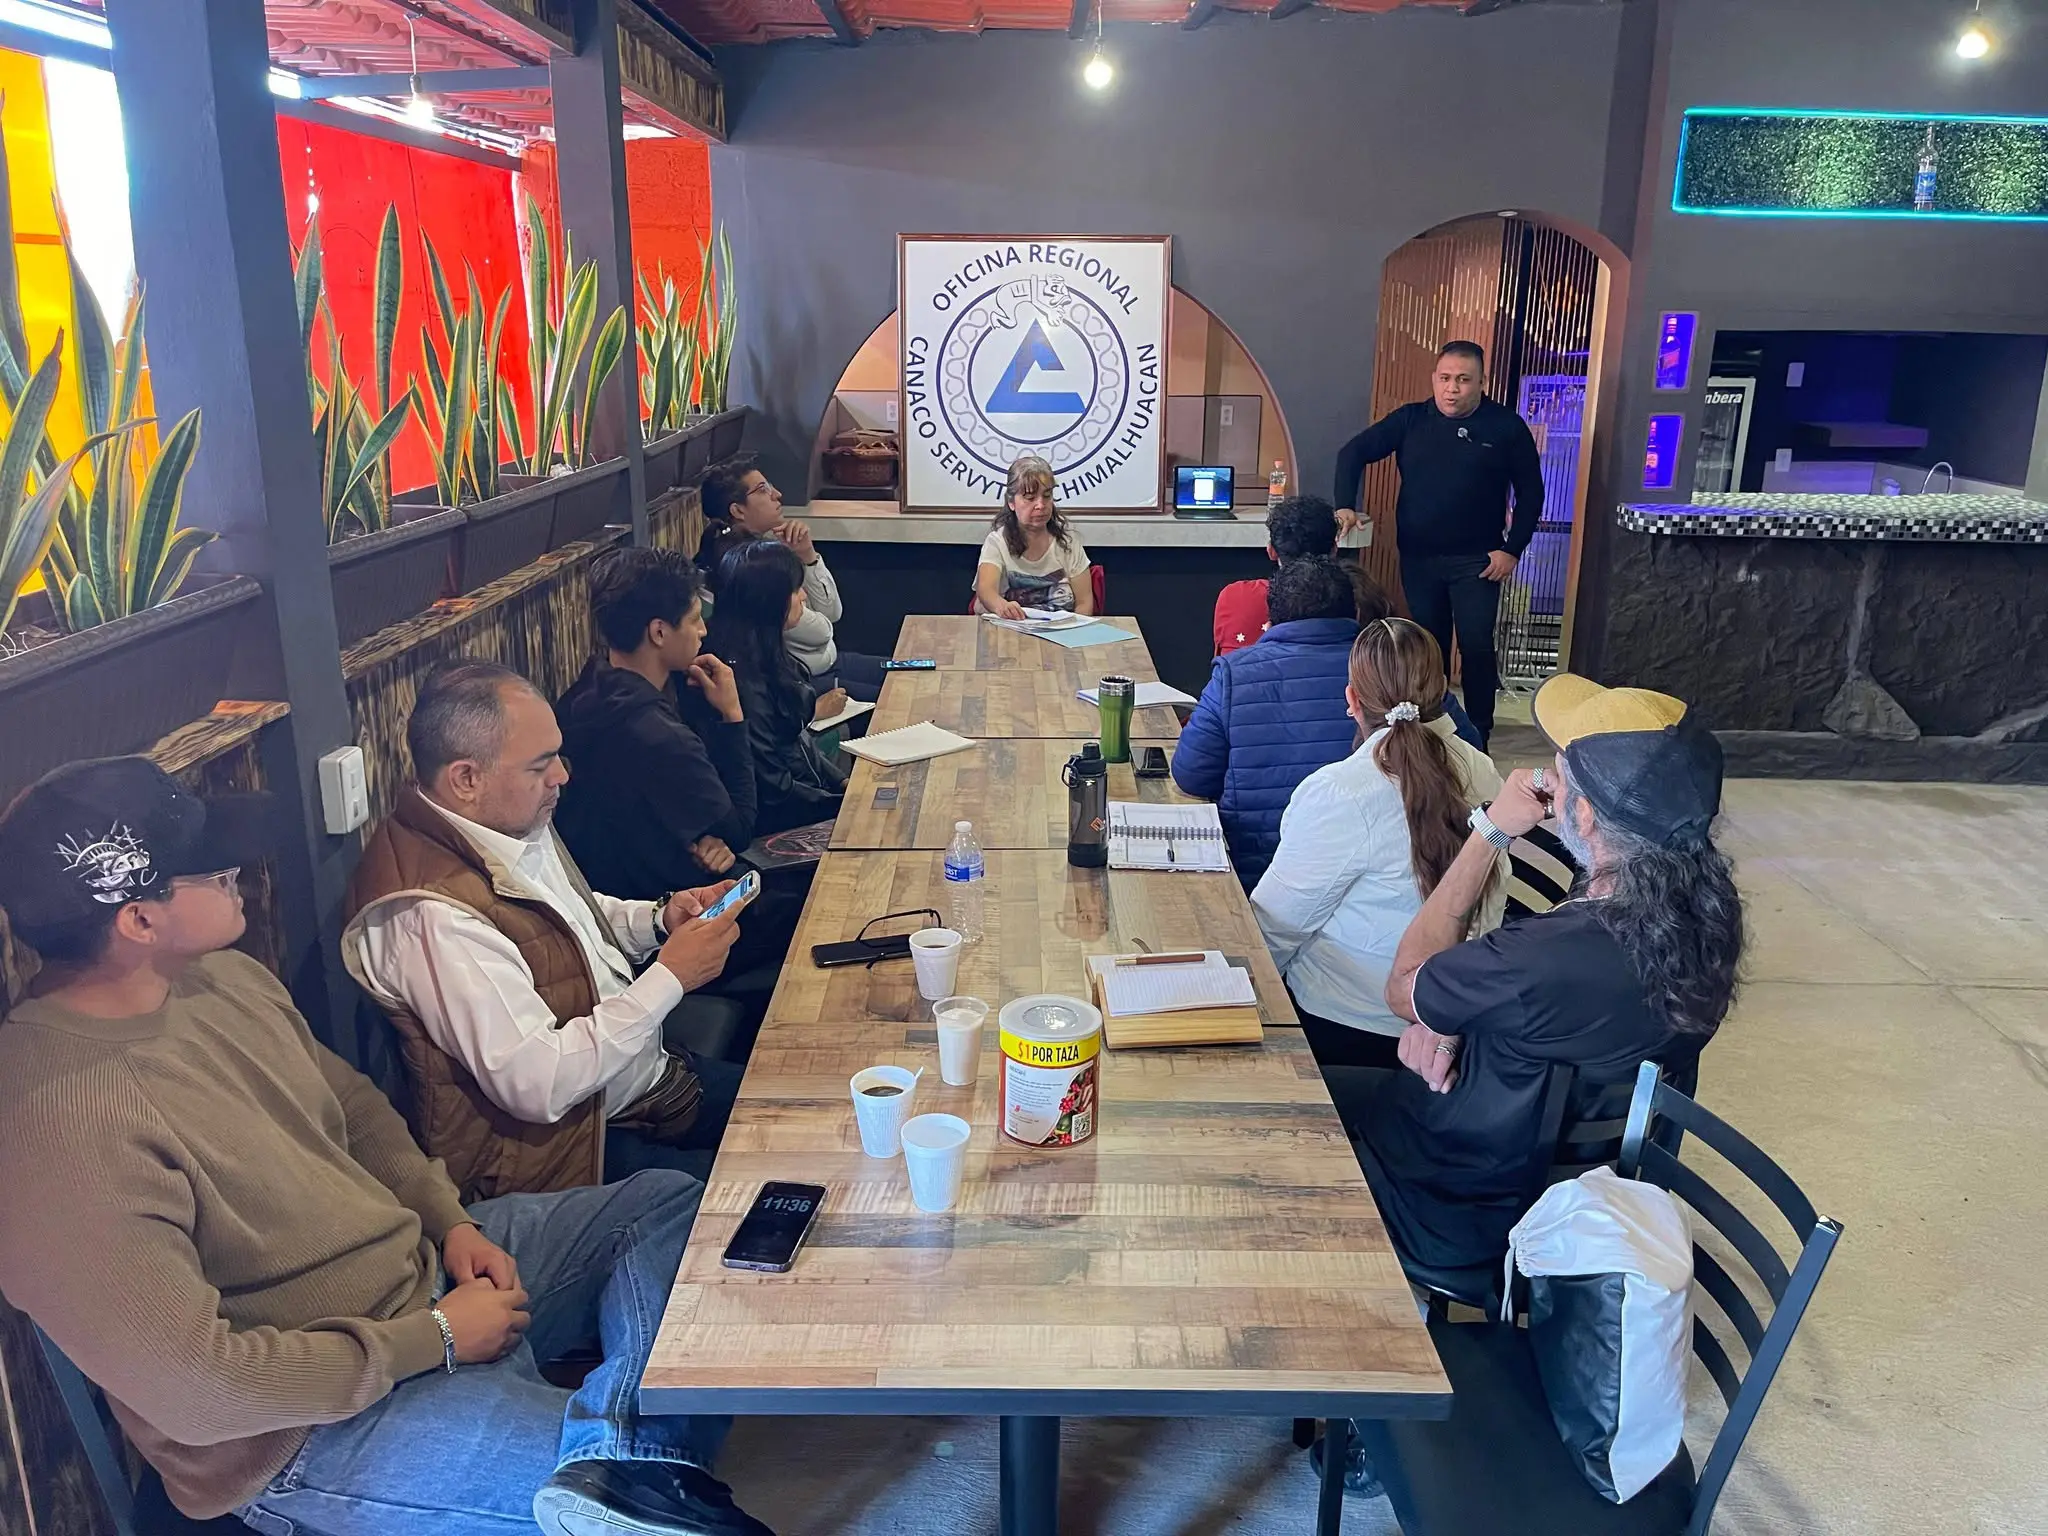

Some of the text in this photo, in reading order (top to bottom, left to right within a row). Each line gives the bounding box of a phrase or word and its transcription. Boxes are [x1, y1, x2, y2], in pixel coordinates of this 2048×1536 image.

[932, 243, 1140, 315] OFICINA REGIONAL
[905, 336, 938, 440] CANACO
[930, 441, 1007, 501] SERVYT
[1032, 1046, 1053, 1062] POR
[1056, 1044, 1079, 1062] TAZA
[763, 1197, 811, 1212] 11:36
